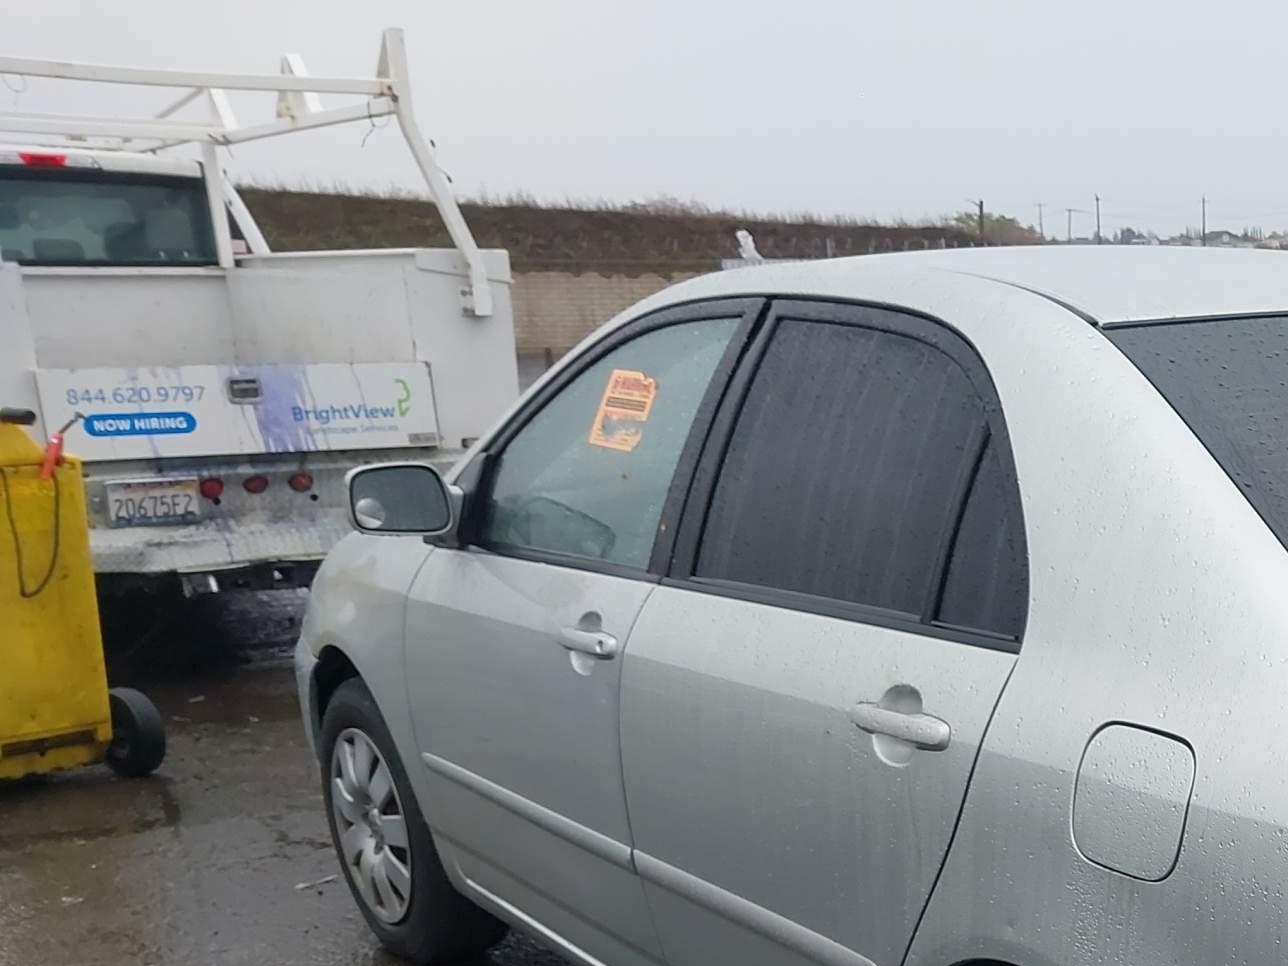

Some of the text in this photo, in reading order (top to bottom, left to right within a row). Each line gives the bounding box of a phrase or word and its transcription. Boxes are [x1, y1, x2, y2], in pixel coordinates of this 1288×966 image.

[66, 385, 206, 406] 844.620.9797
[291, 404, 395, 424] BrightView
[93, 417, 188, 432] NOW HIRING
